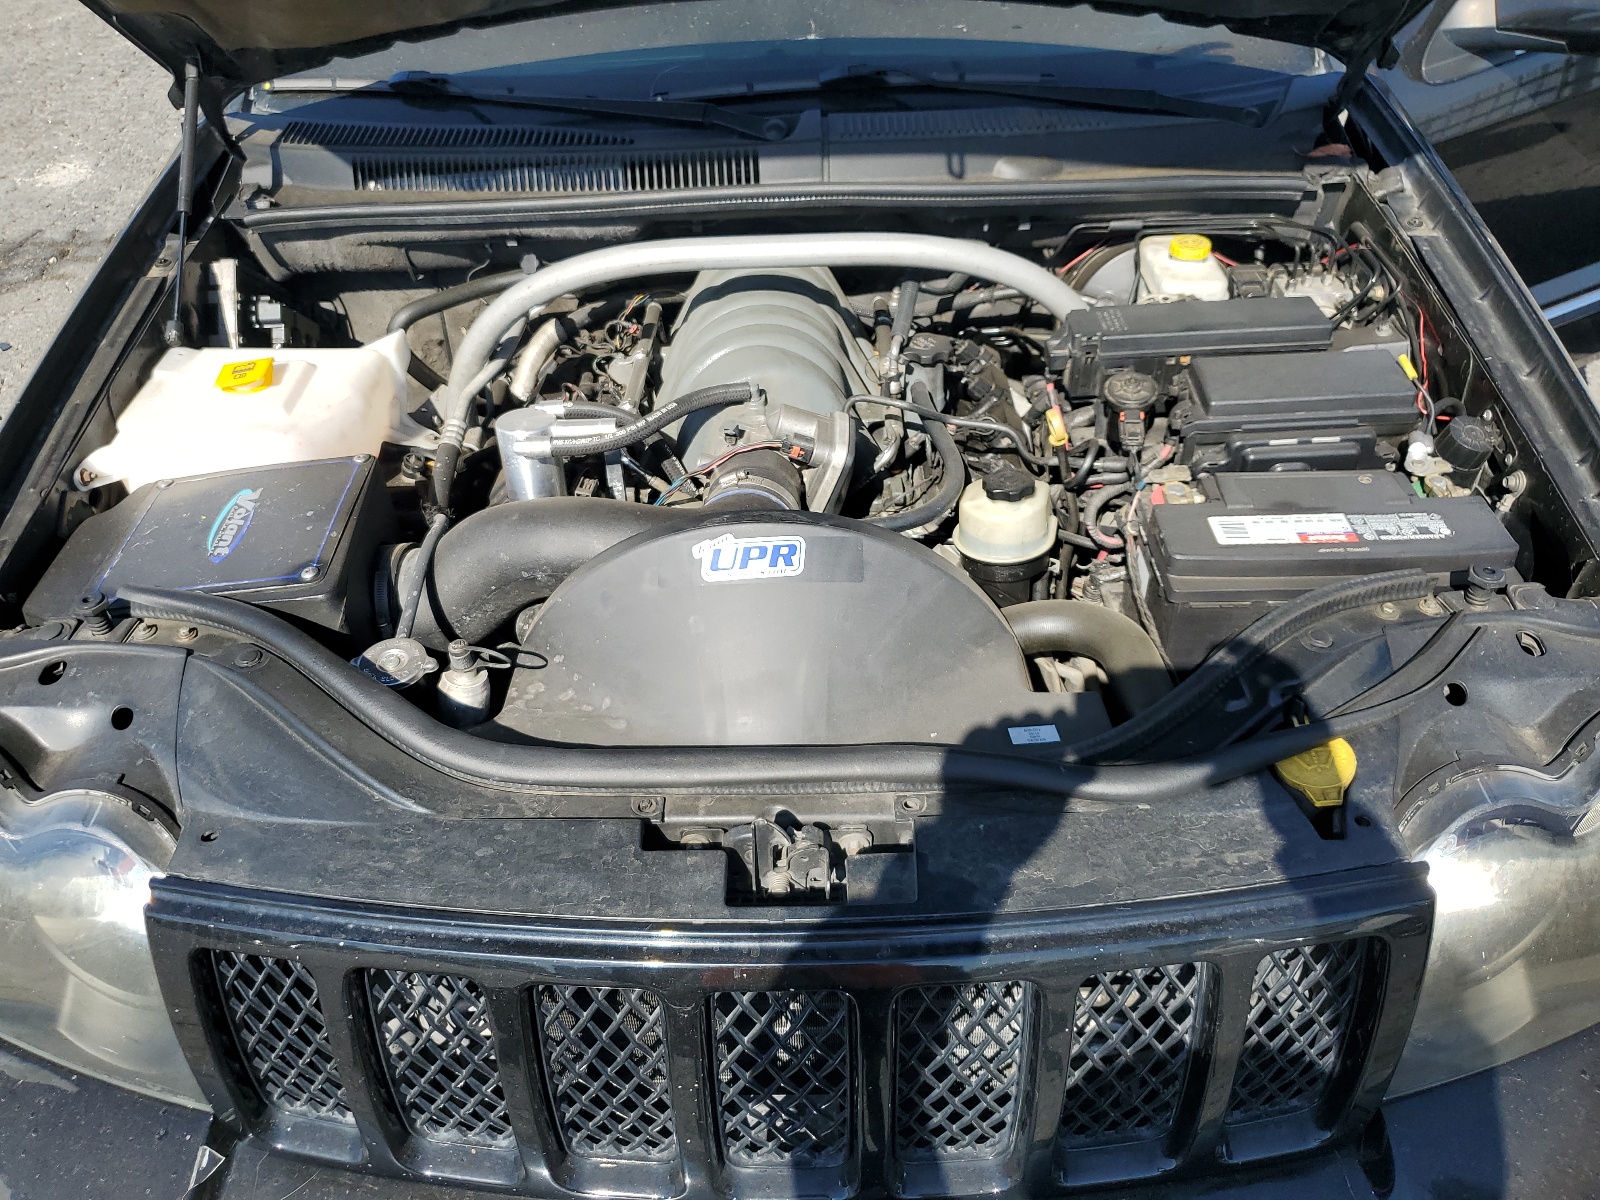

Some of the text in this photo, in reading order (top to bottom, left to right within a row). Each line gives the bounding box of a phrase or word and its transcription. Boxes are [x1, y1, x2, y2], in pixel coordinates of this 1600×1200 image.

[646, 411, 662, 422] MADE
[213, 487, 264, 557] Volant
[709, 543, 798, 572] UPR
